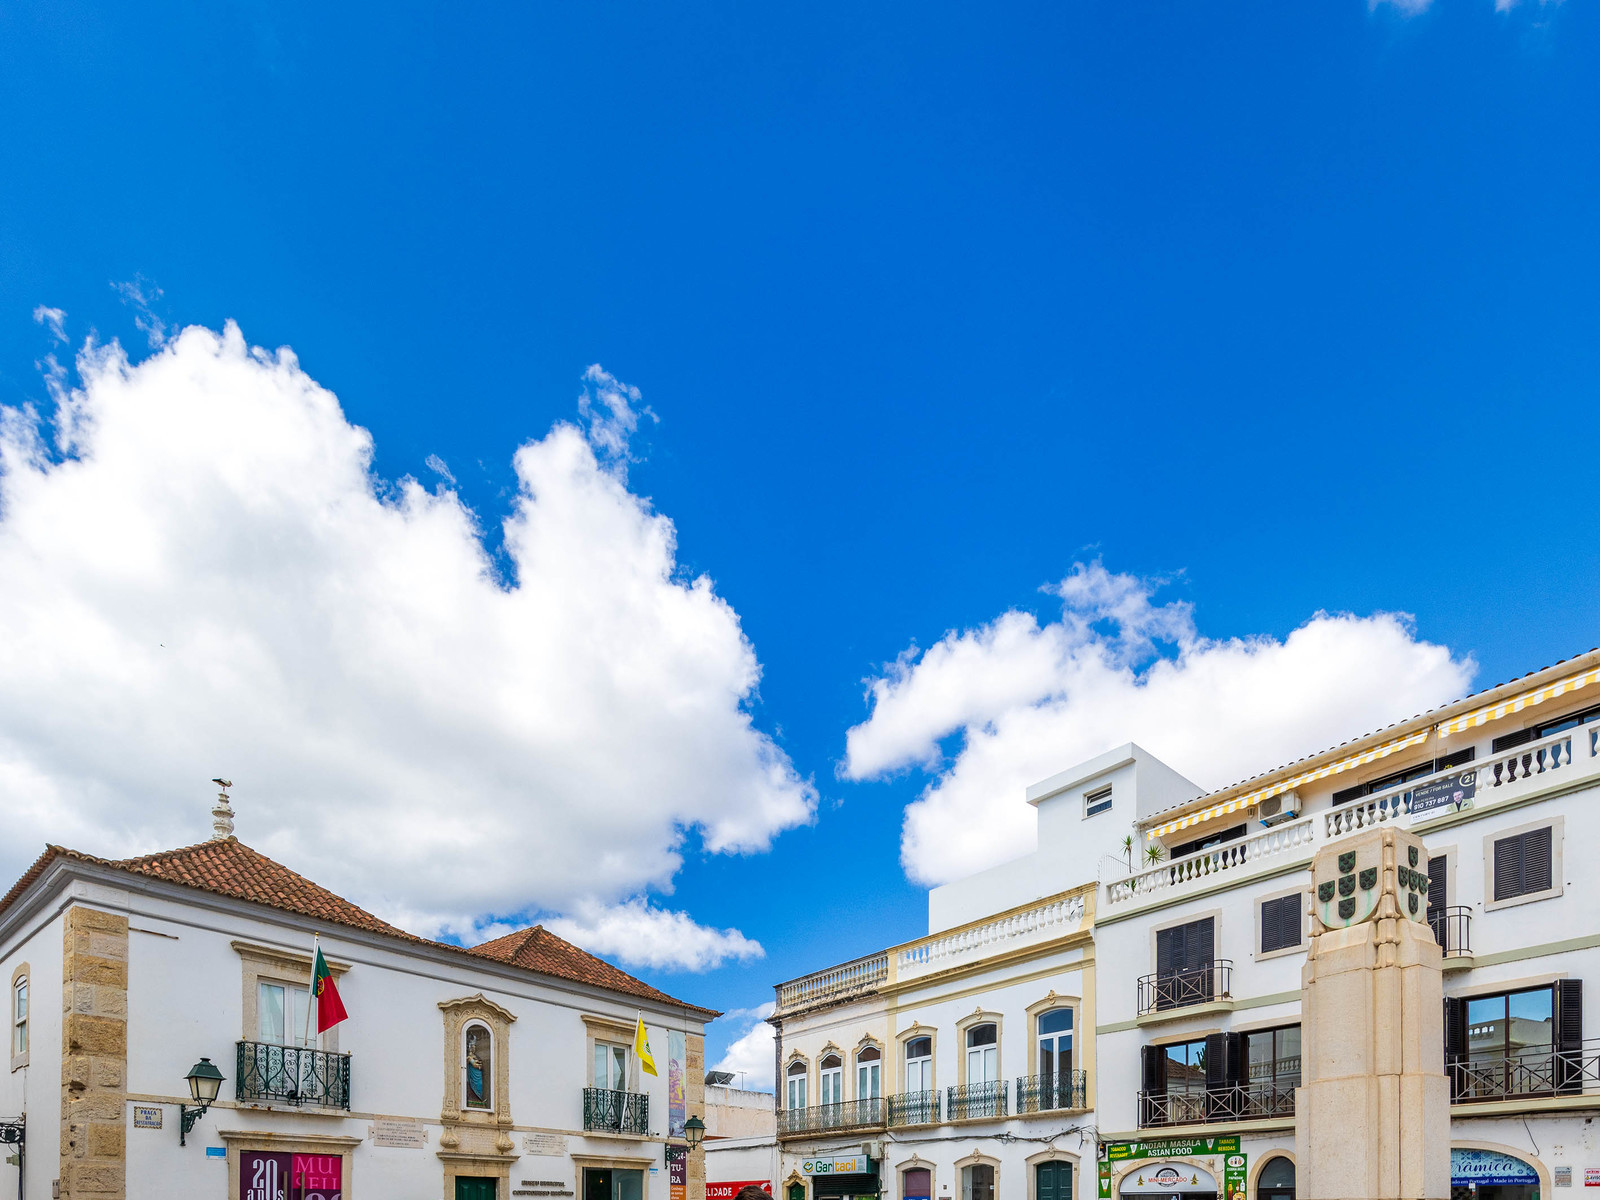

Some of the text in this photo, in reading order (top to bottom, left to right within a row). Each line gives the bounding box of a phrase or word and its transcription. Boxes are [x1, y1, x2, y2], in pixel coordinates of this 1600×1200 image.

[1140, 1139, 1201, 1150] INDIAN MASALA
[1147, 1147, 1193, 1157] ASIAN FOOD
[295, 1156, 333, 1174] MU
[705, 1187, 732, 1197] LIDADE
